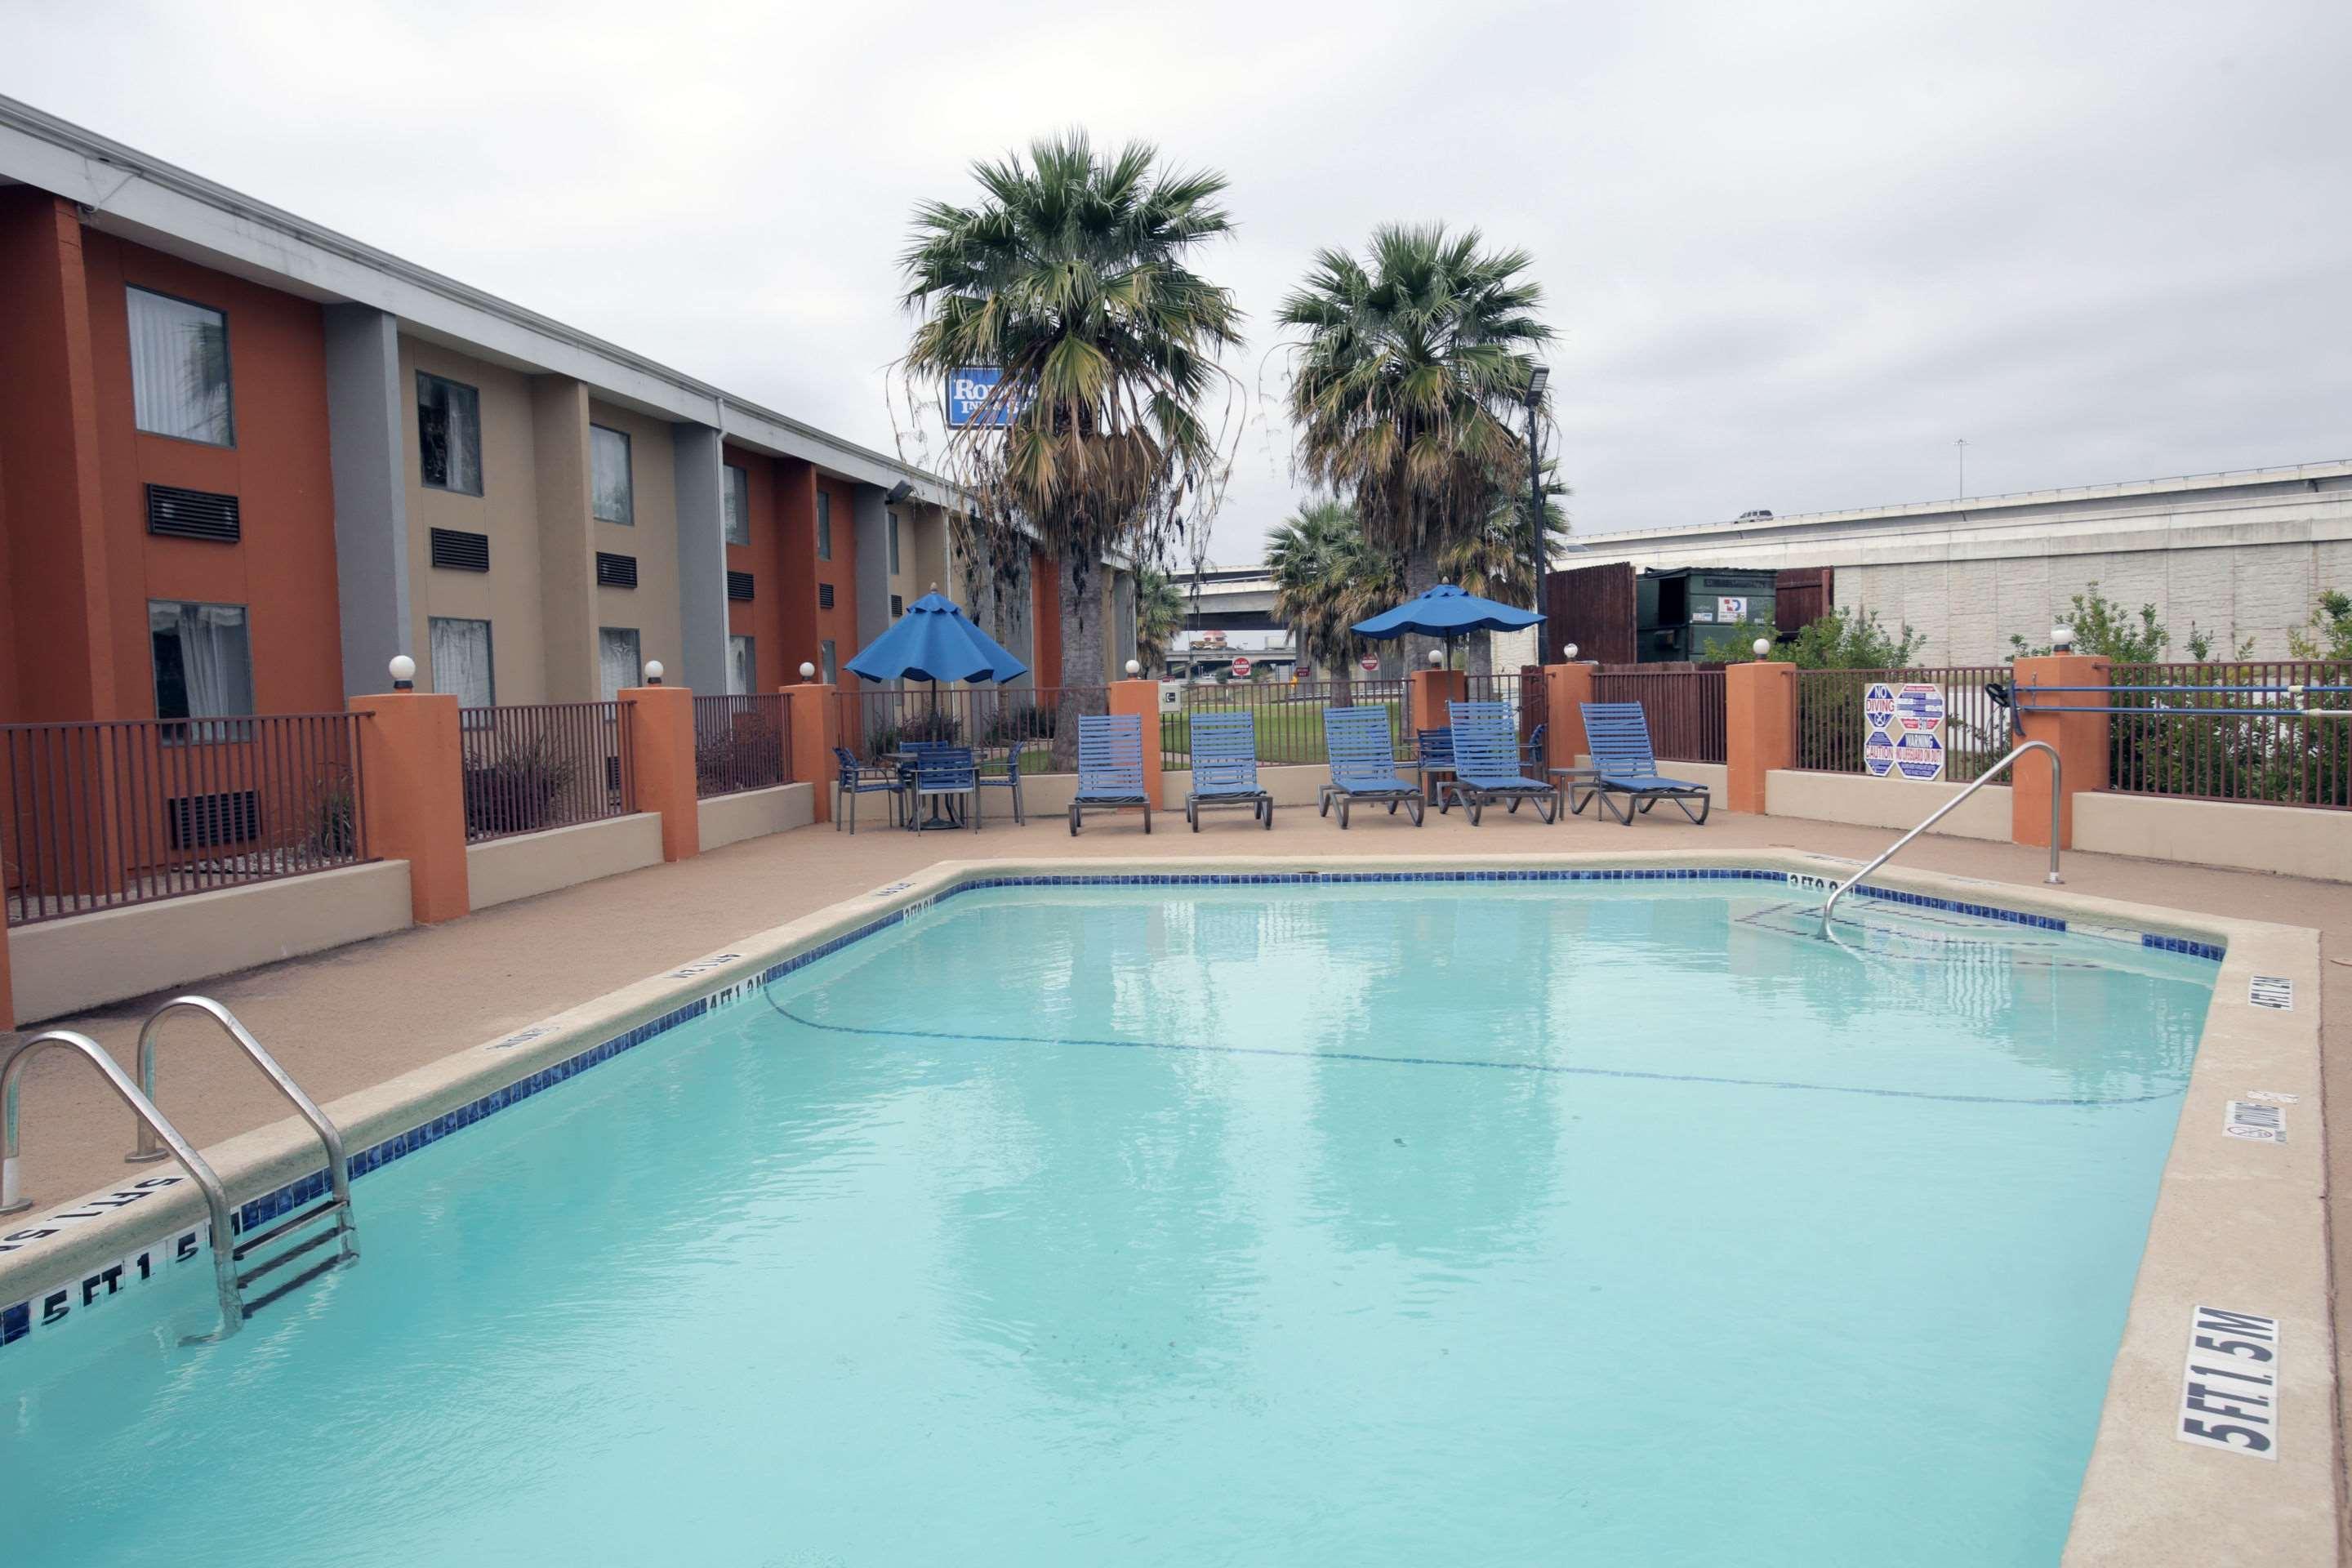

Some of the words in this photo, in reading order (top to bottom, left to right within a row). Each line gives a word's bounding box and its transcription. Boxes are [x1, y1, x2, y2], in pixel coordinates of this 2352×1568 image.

[1874, 686, 1886, 698] NO
[1866, 699, 1895, 712] DIVING
[1905, 733, 1933, 748] WARNING
[1865, 745, 1893, 759] CAUTION
[41, 1290, 71, 1326] 5
